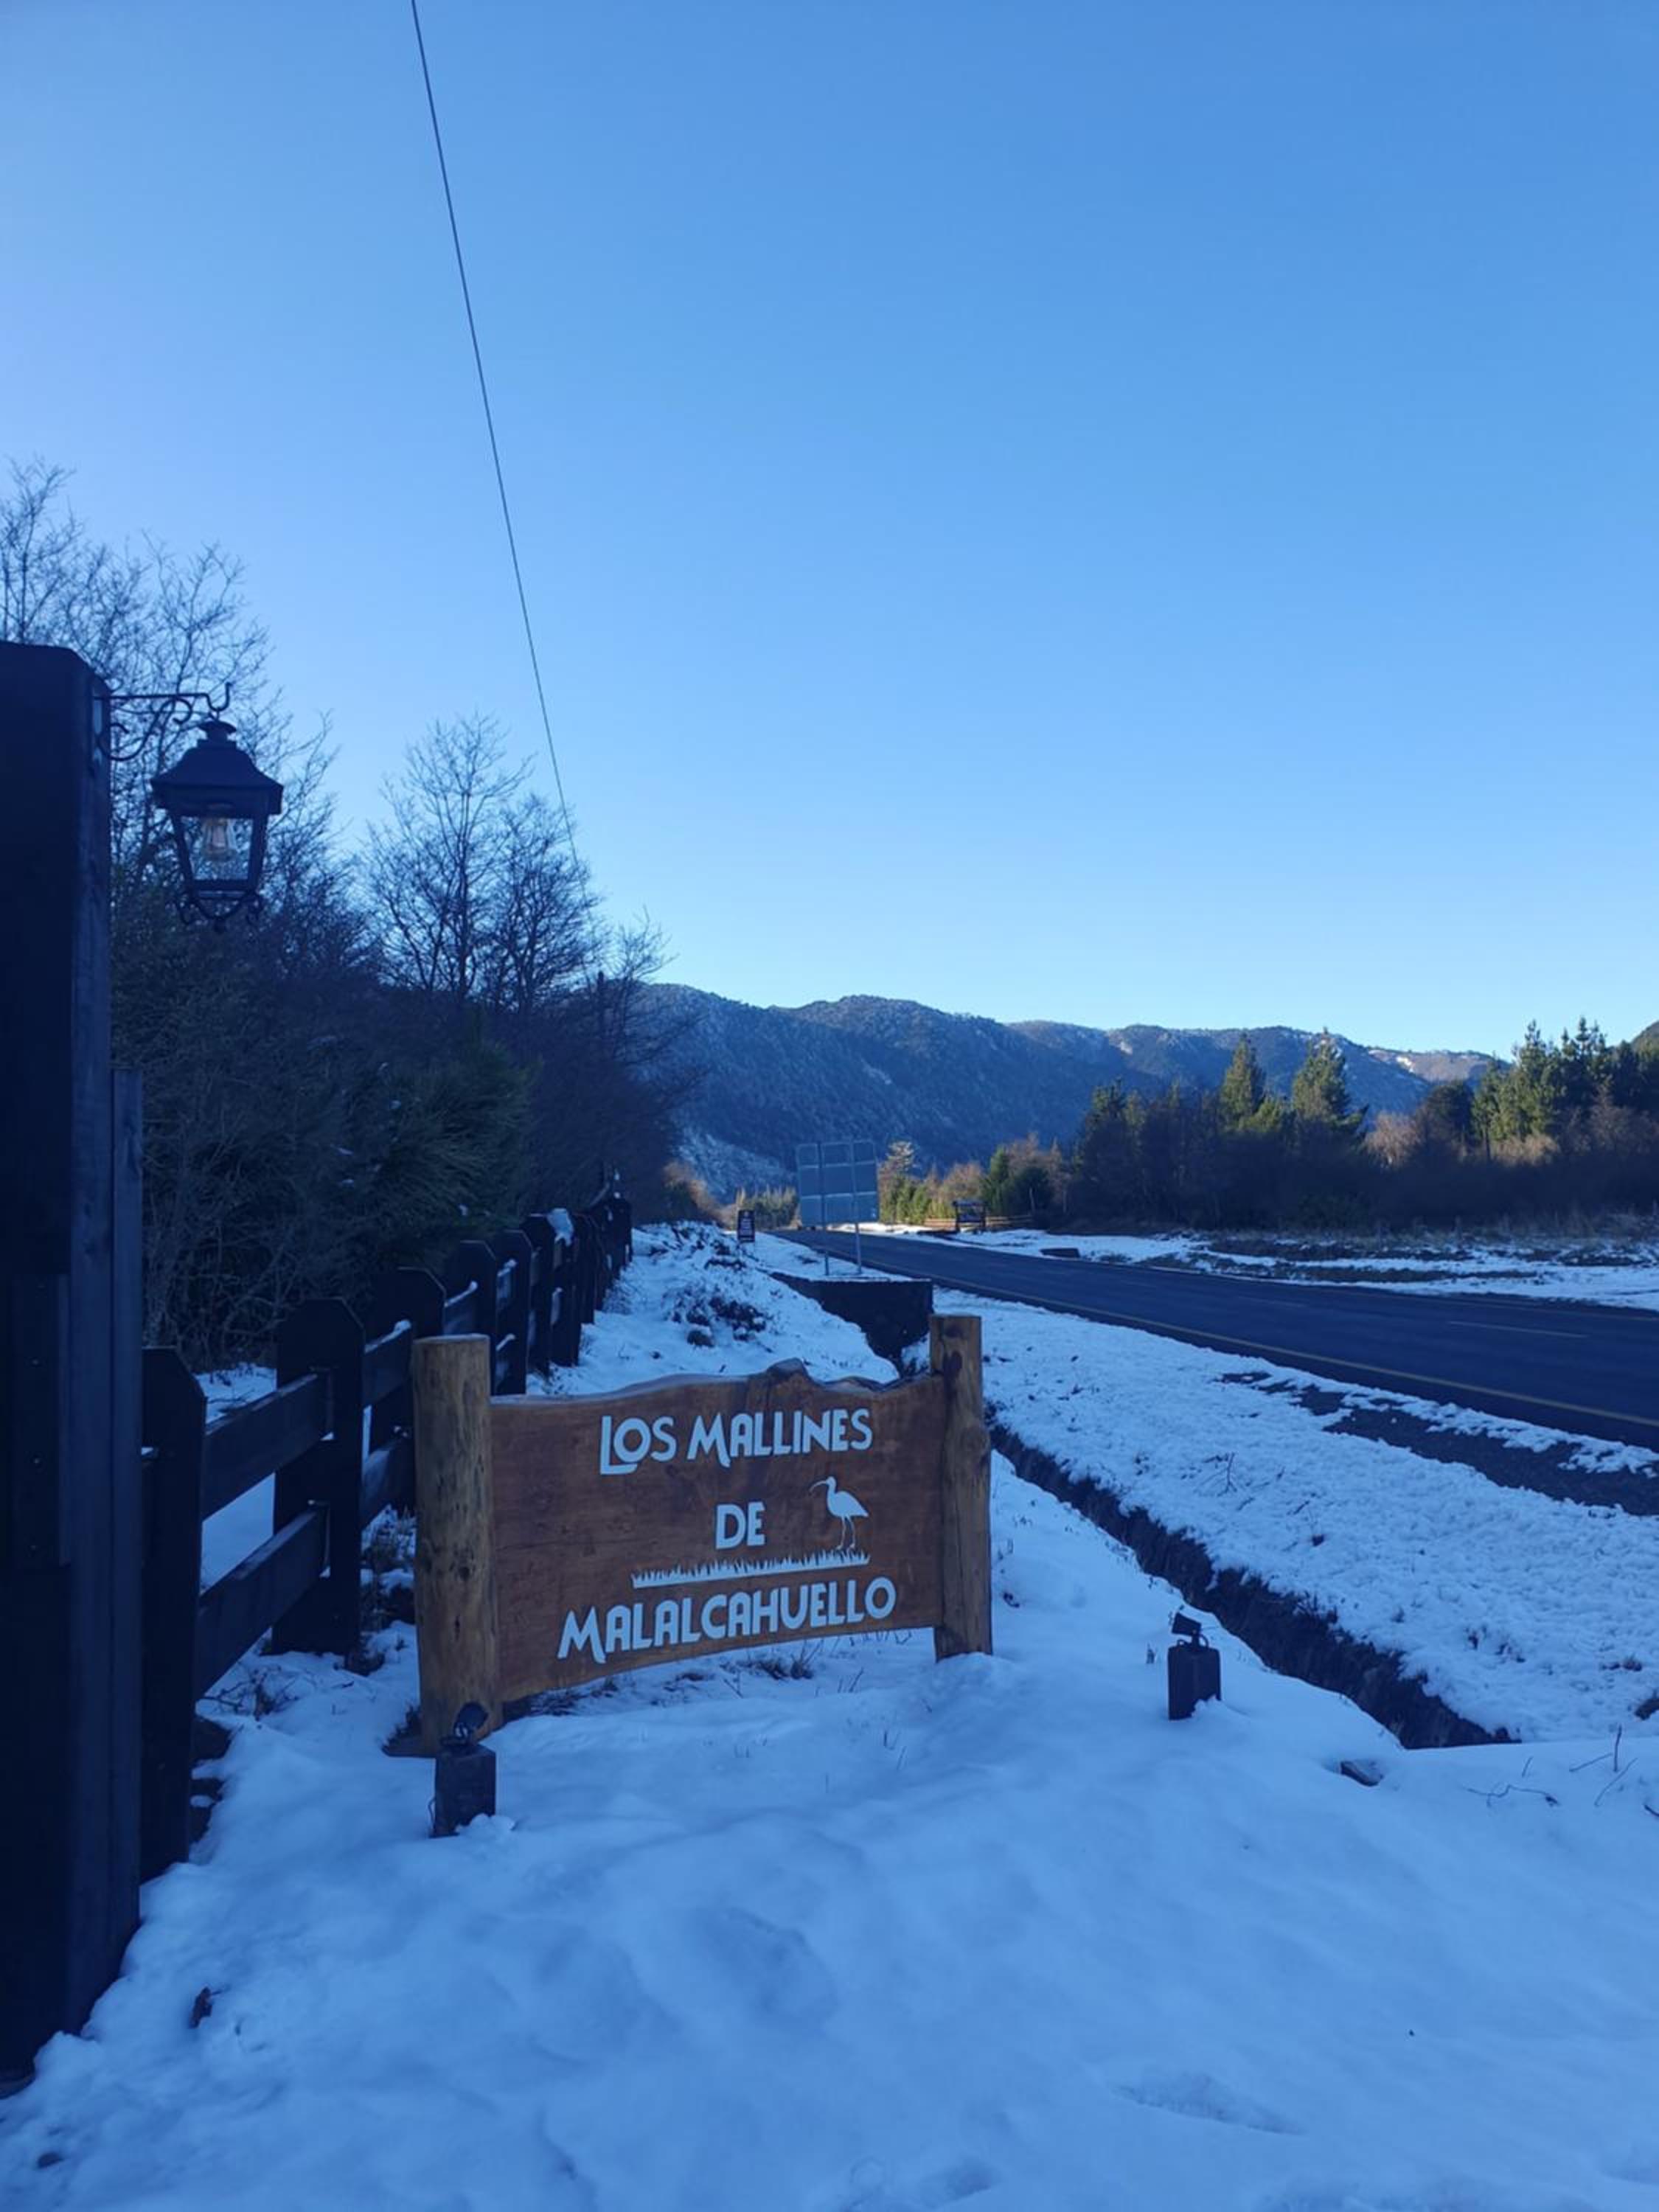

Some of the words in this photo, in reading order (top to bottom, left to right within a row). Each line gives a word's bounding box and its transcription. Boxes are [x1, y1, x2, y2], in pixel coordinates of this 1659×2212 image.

[599, 1415, 677, 1475] LOS
[686, 1408, 873, 1468] MALLINES
[715, 1501, 765, 1550] DE
[557, 1576, 897, 1664] MALALCAHUELLO
